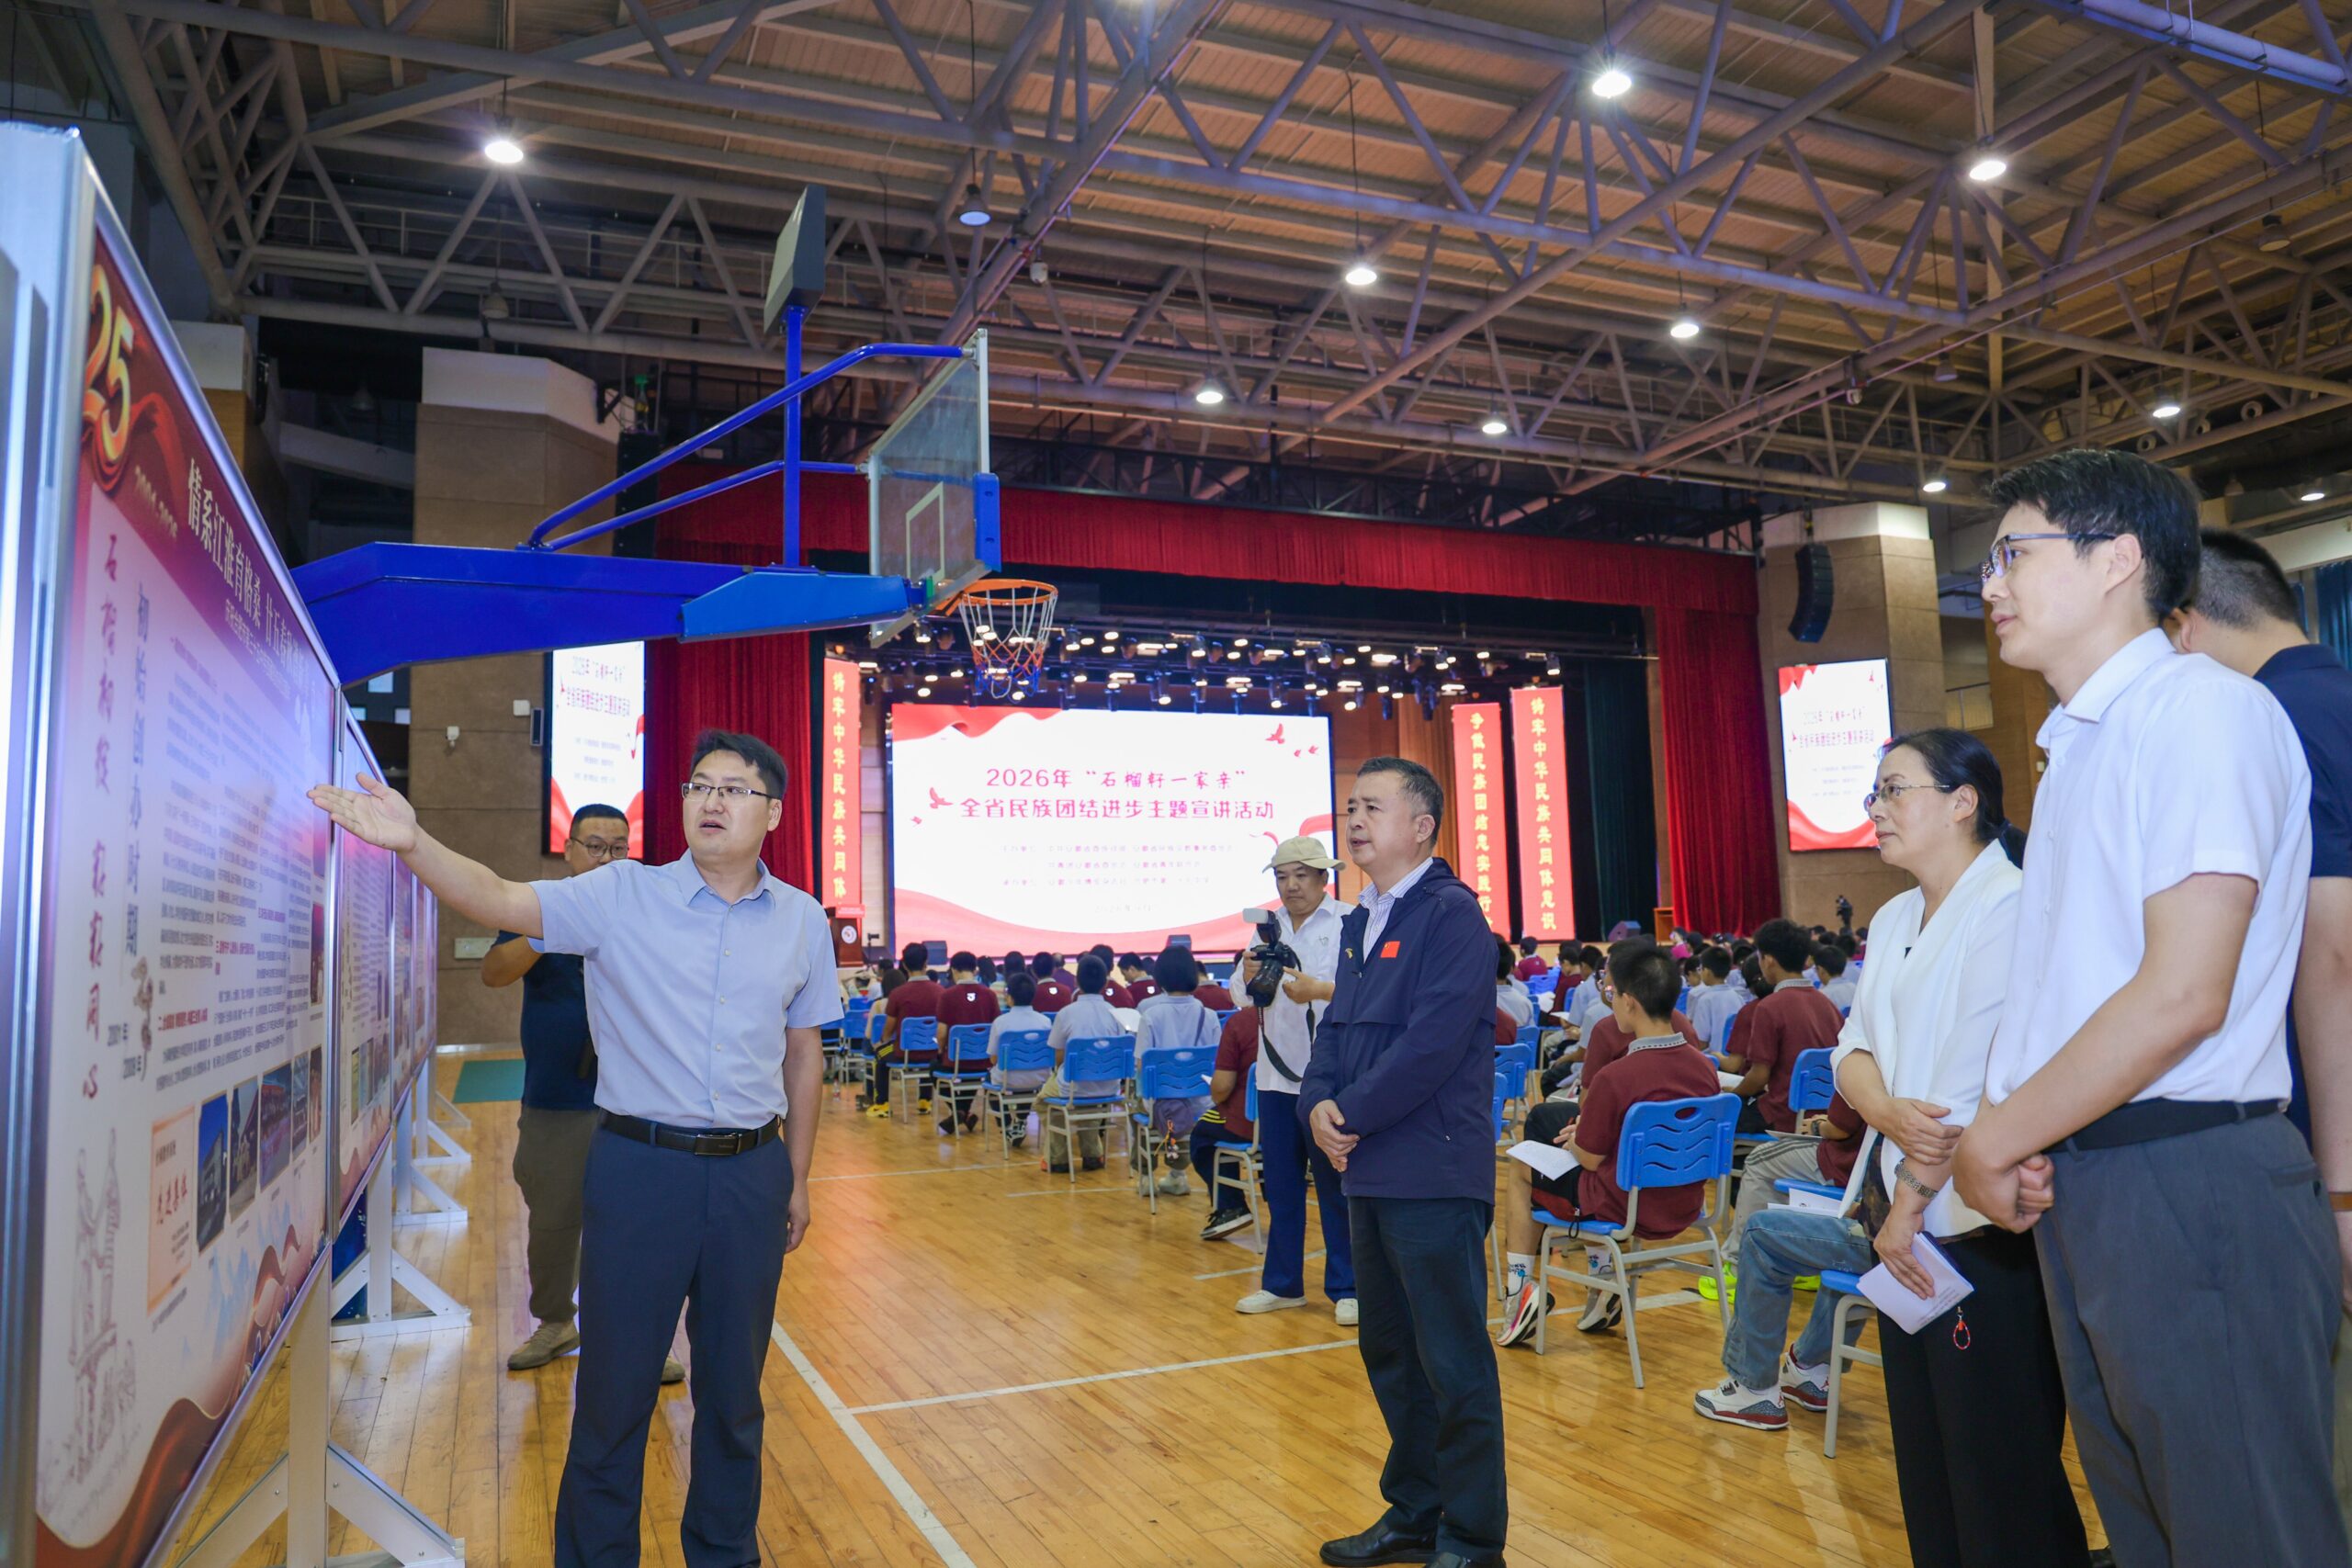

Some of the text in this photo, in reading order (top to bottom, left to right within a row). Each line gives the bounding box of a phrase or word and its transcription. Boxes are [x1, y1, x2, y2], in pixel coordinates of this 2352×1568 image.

[187, 457, 261, 628] 情系江淮育格桑
[831, 671, 847, 905] 铸牢中华民族共同体
[960, 797, 1274, 819] 全省民族团结进步主题宣讲活动
[1529, 696, 1556, 931] 铸牢中华民族共同体意识
